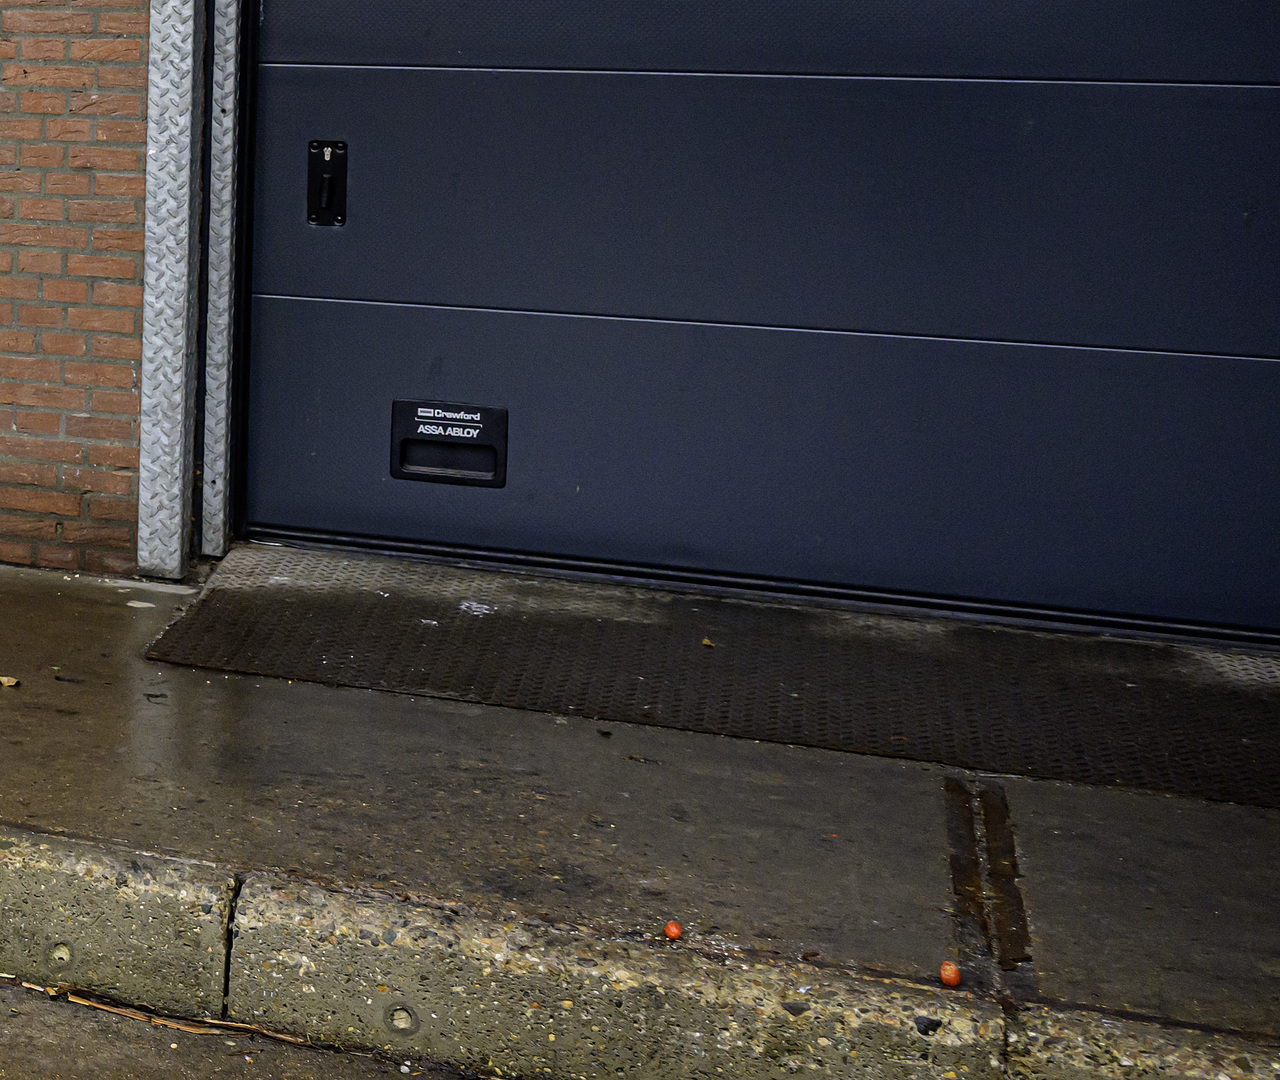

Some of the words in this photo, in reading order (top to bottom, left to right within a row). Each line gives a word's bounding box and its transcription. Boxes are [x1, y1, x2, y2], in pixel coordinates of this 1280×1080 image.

[434, 409, 481, 421] Crawford
[417, 424, 444, 435] ASSA
[445, 426, 480, 438] ABLOY
